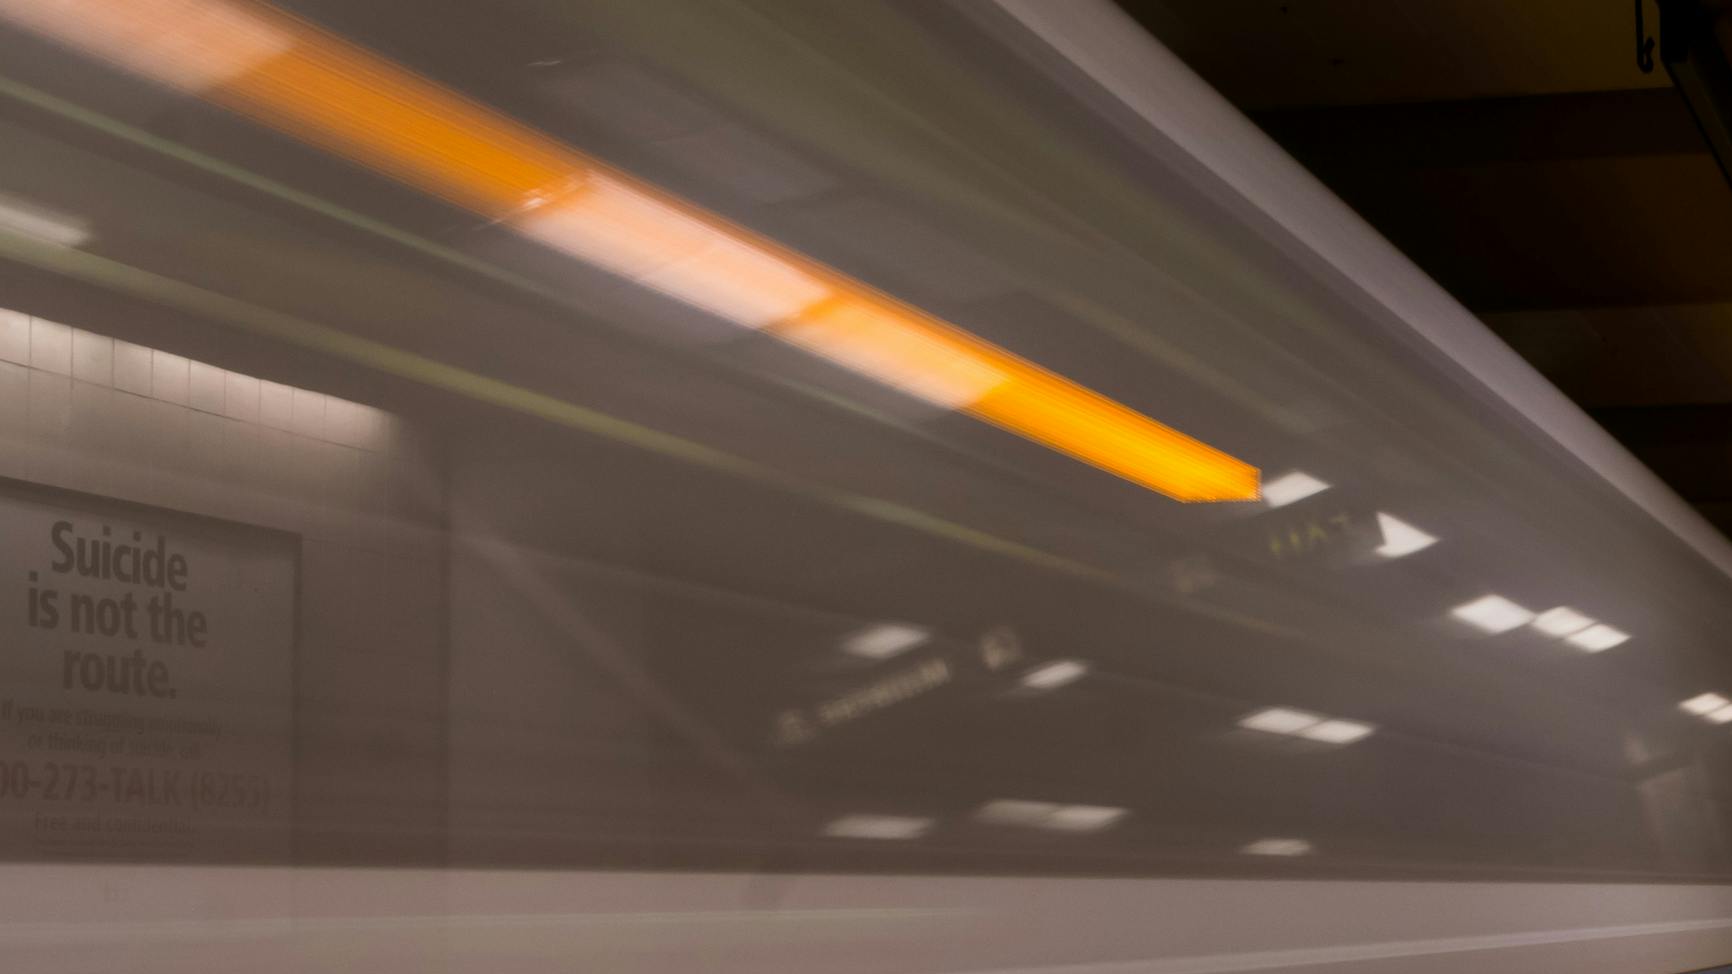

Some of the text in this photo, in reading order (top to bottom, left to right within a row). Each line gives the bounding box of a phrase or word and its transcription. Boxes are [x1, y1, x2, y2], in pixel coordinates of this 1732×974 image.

[51, 520, 188, 591] Suicide
[28, 570, 208, 648] is not the
[63, 649, 177, 699] route.
[17, 708, 45, 725] you
[48, 709, 73, 725] are
[48, 733, 105, 758] thinking
[110, 737, 126, 753] of
